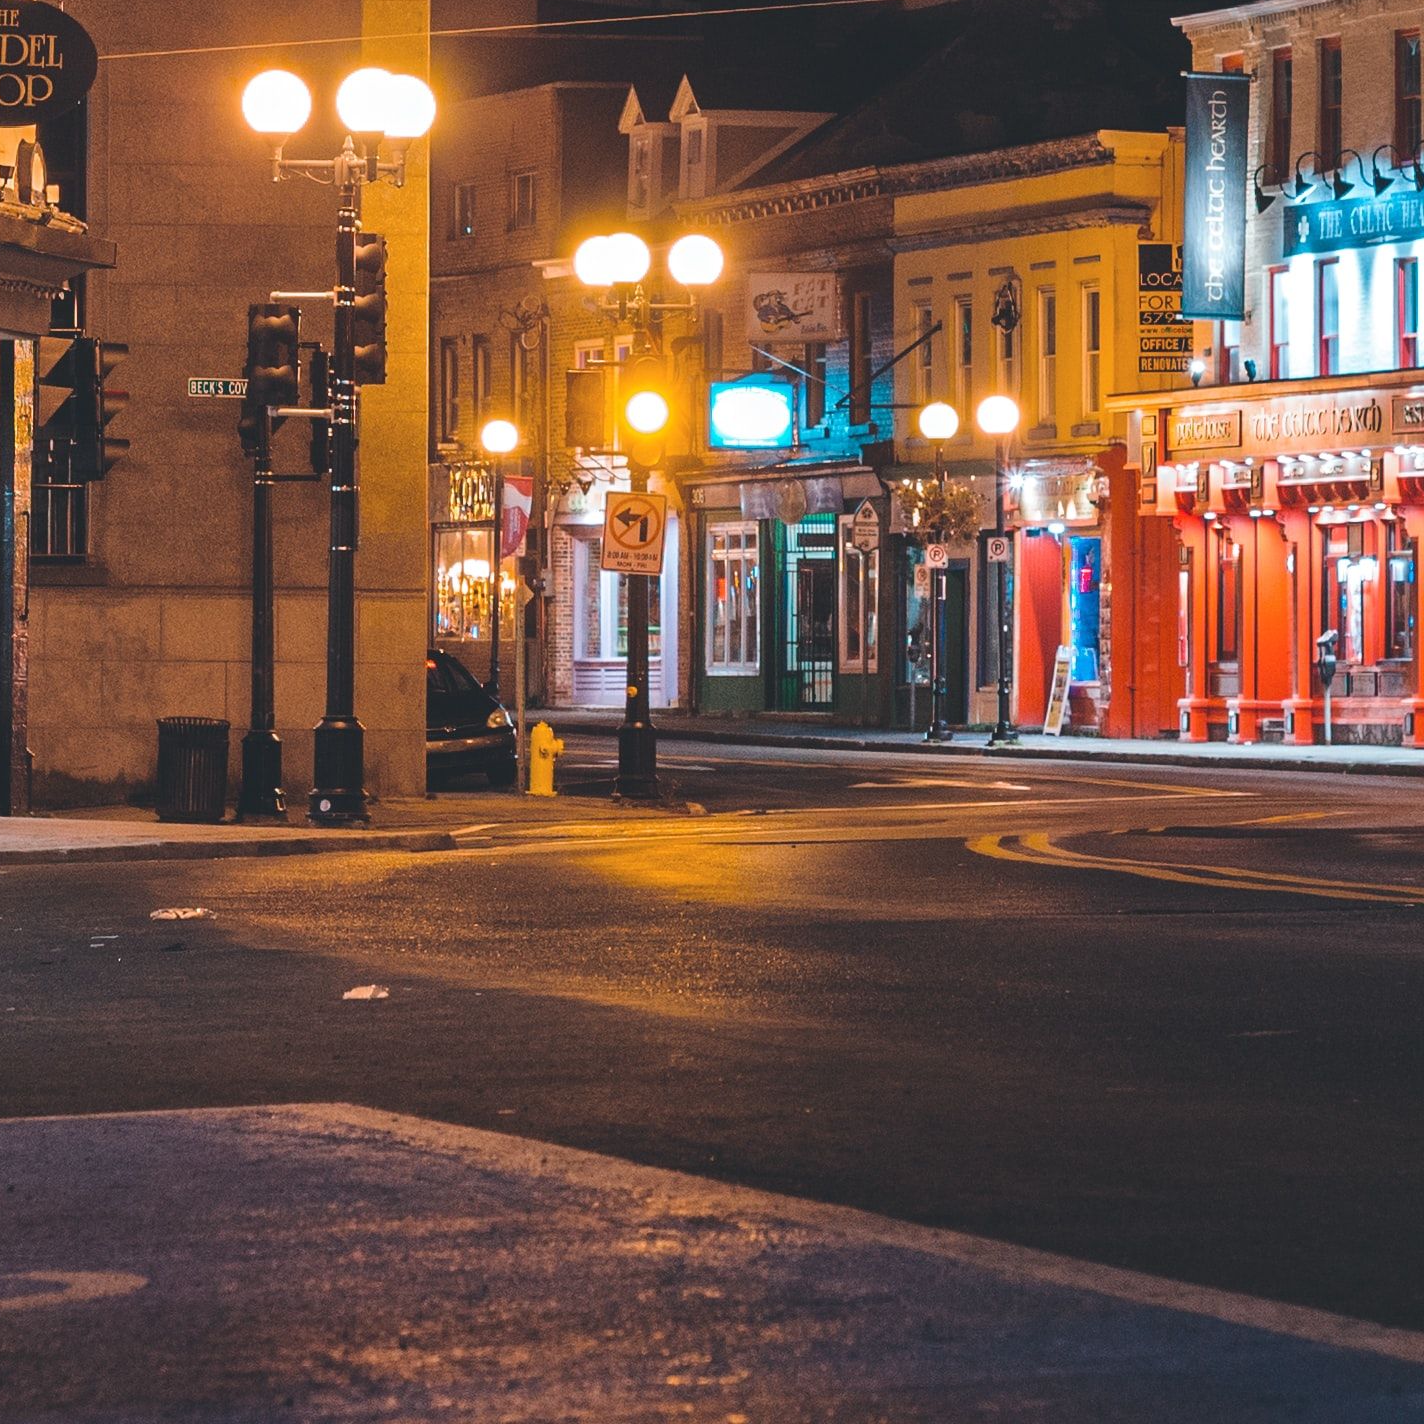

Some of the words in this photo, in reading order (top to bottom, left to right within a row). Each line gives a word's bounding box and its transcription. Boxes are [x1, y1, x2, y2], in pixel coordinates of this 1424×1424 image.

[1318, 209, 1343, 240] THE
[1350, 202, 1394, 235] CELTIC
[1138, 295, 1173, 310] FOR
[1141, 338, 1179, 351] OFFICE
[190, 380, 224, 394] BECK'S
